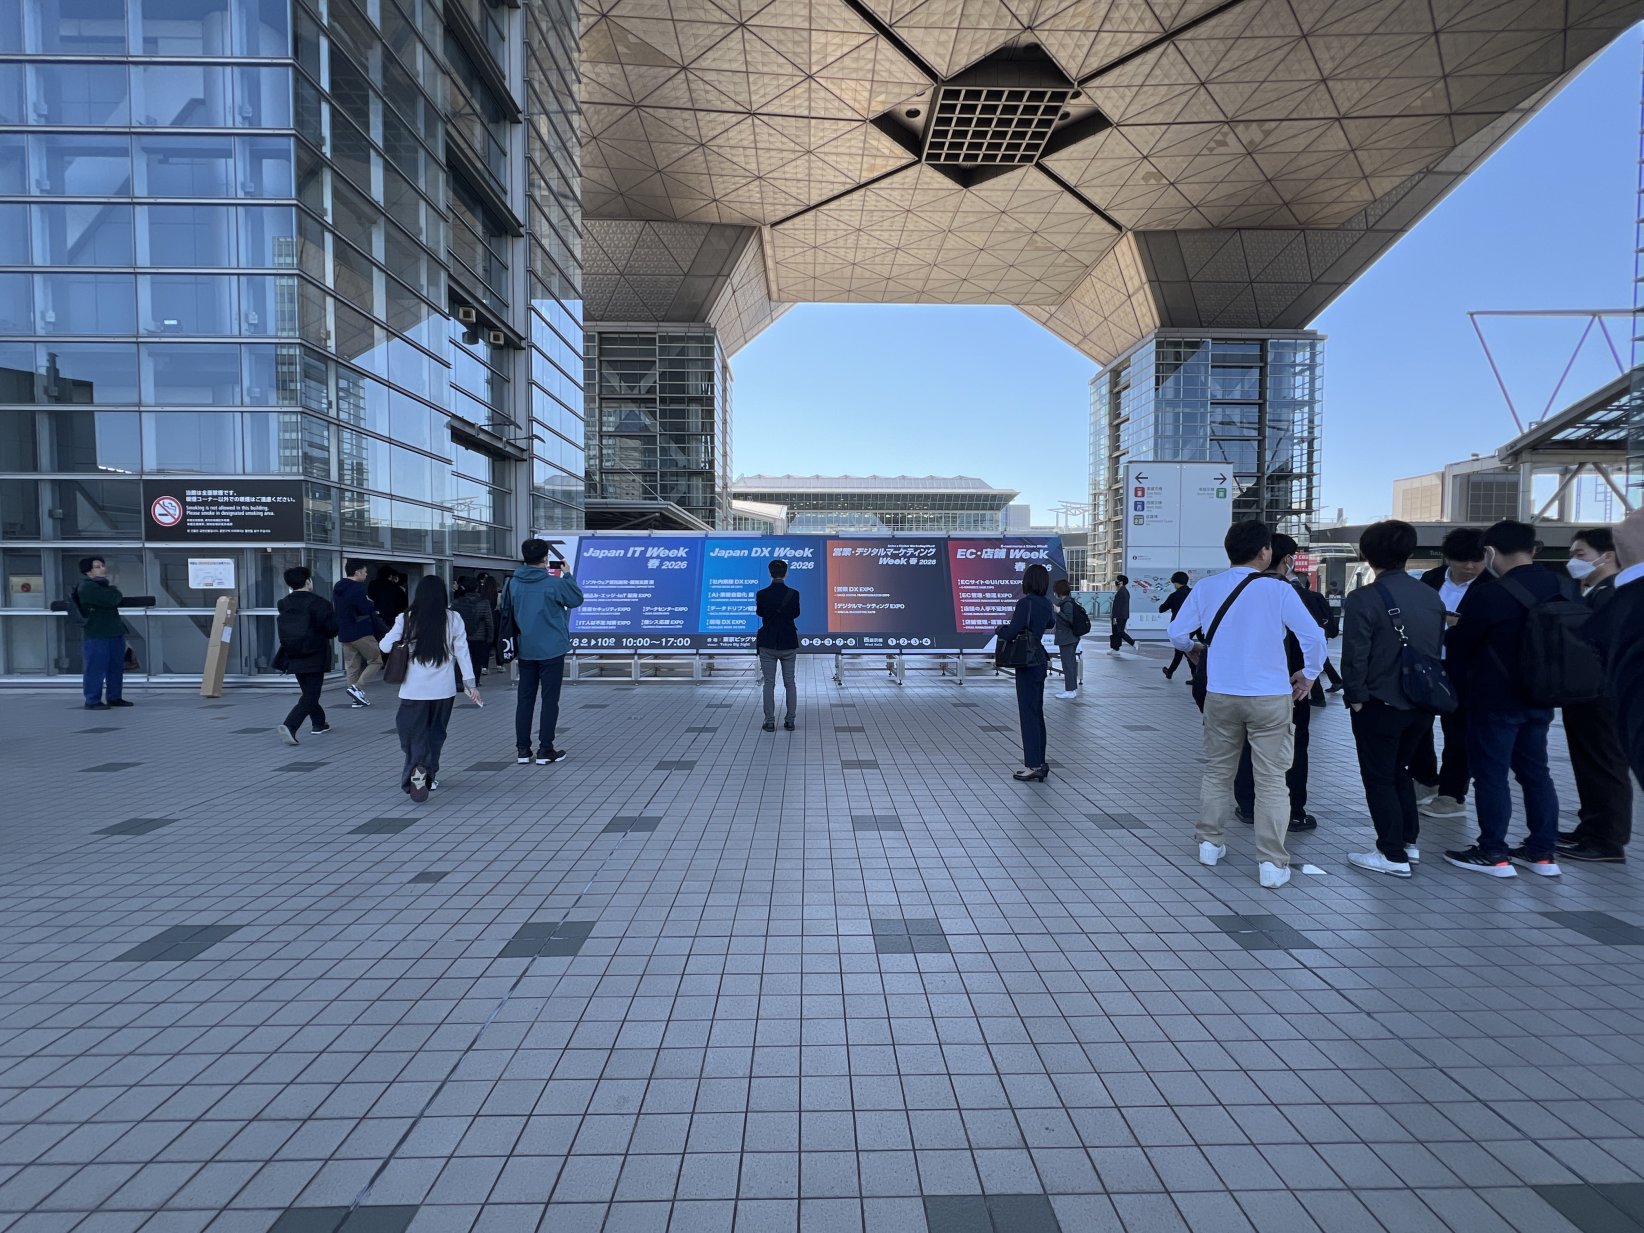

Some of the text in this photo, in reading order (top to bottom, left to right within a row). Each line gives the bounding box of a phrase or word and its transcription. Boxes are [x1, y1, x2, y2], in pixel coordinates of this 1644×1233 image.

[584, 547, 689, 558] Japan IT Week
[710, 548, 814, 558] Japan DX Week
[1009, 549, 1049, 559] Week
[647, 559, 660, 569] 春
[790, 560, 814, 569] 2026
[1014, 562, 1026, 572] 春
